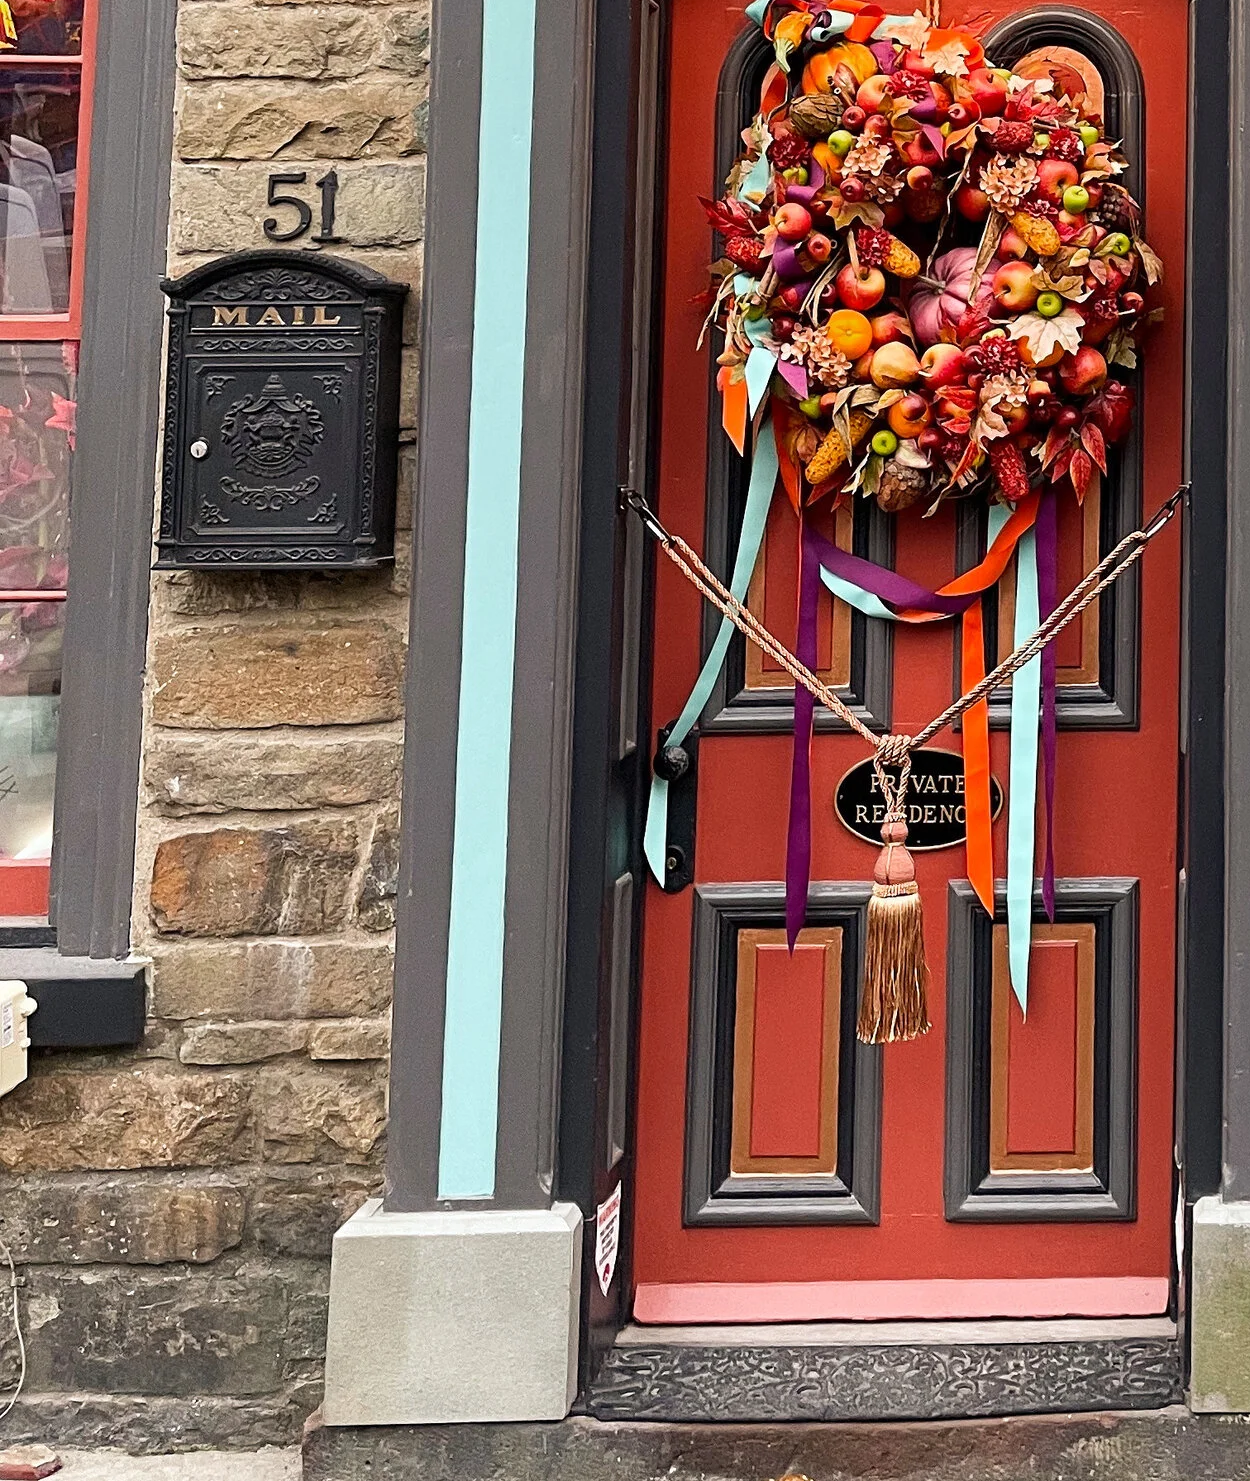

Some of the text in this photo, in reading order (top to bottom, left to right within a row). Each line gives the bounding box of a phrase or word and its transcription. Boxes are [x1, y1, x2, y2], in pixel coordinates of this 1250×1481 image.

[263, 170, 341, 242] 51
[211, 305, 341, 327] MAIL
[870, 773, 966, 794] PRVATE
